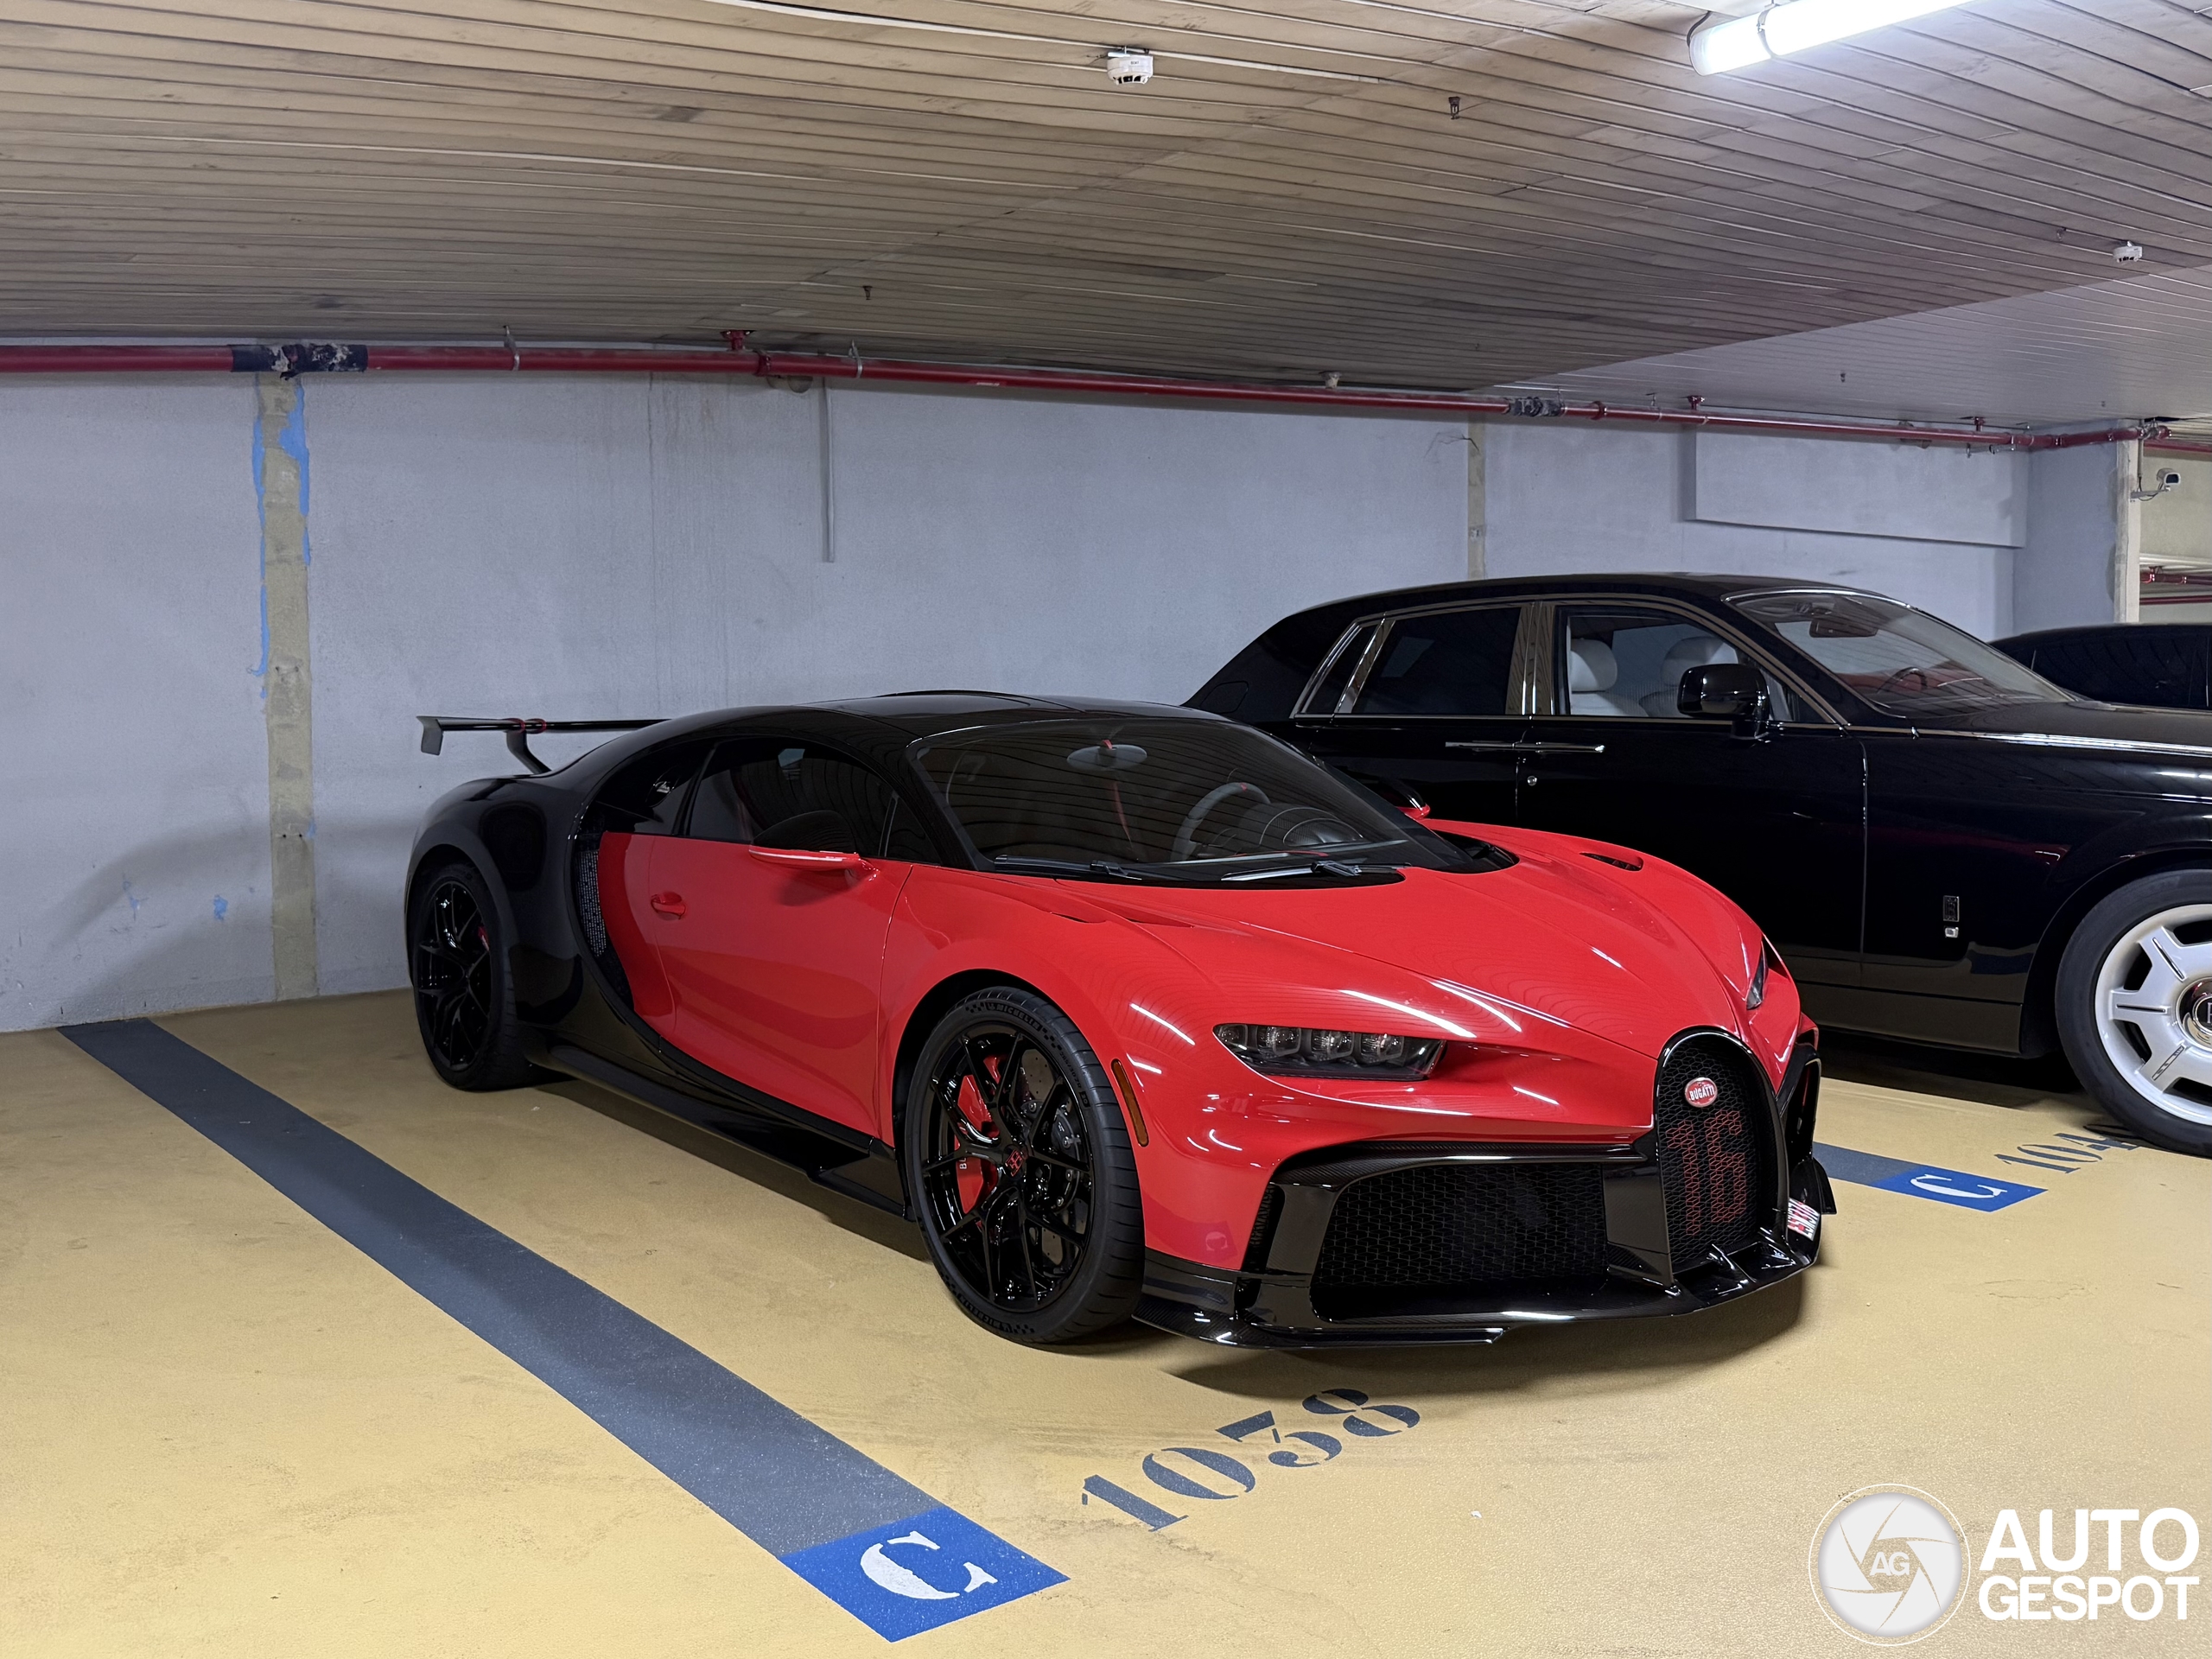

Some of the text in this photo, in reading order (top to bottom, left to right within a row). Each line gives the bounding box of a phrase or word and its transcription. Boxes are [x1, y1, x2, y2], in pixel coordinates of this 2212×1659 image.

[996, 1004, 1040, 1030] MICHELIN
[1689, 1085, 1714, 1101] BUGATTI
[1665, 1109, 1746, 1236] 16
[1910, 1173, 2007, 1199] C
[1082, 1389, 1421, 1532] 1038
[860, 1530, 998, 1600] C
